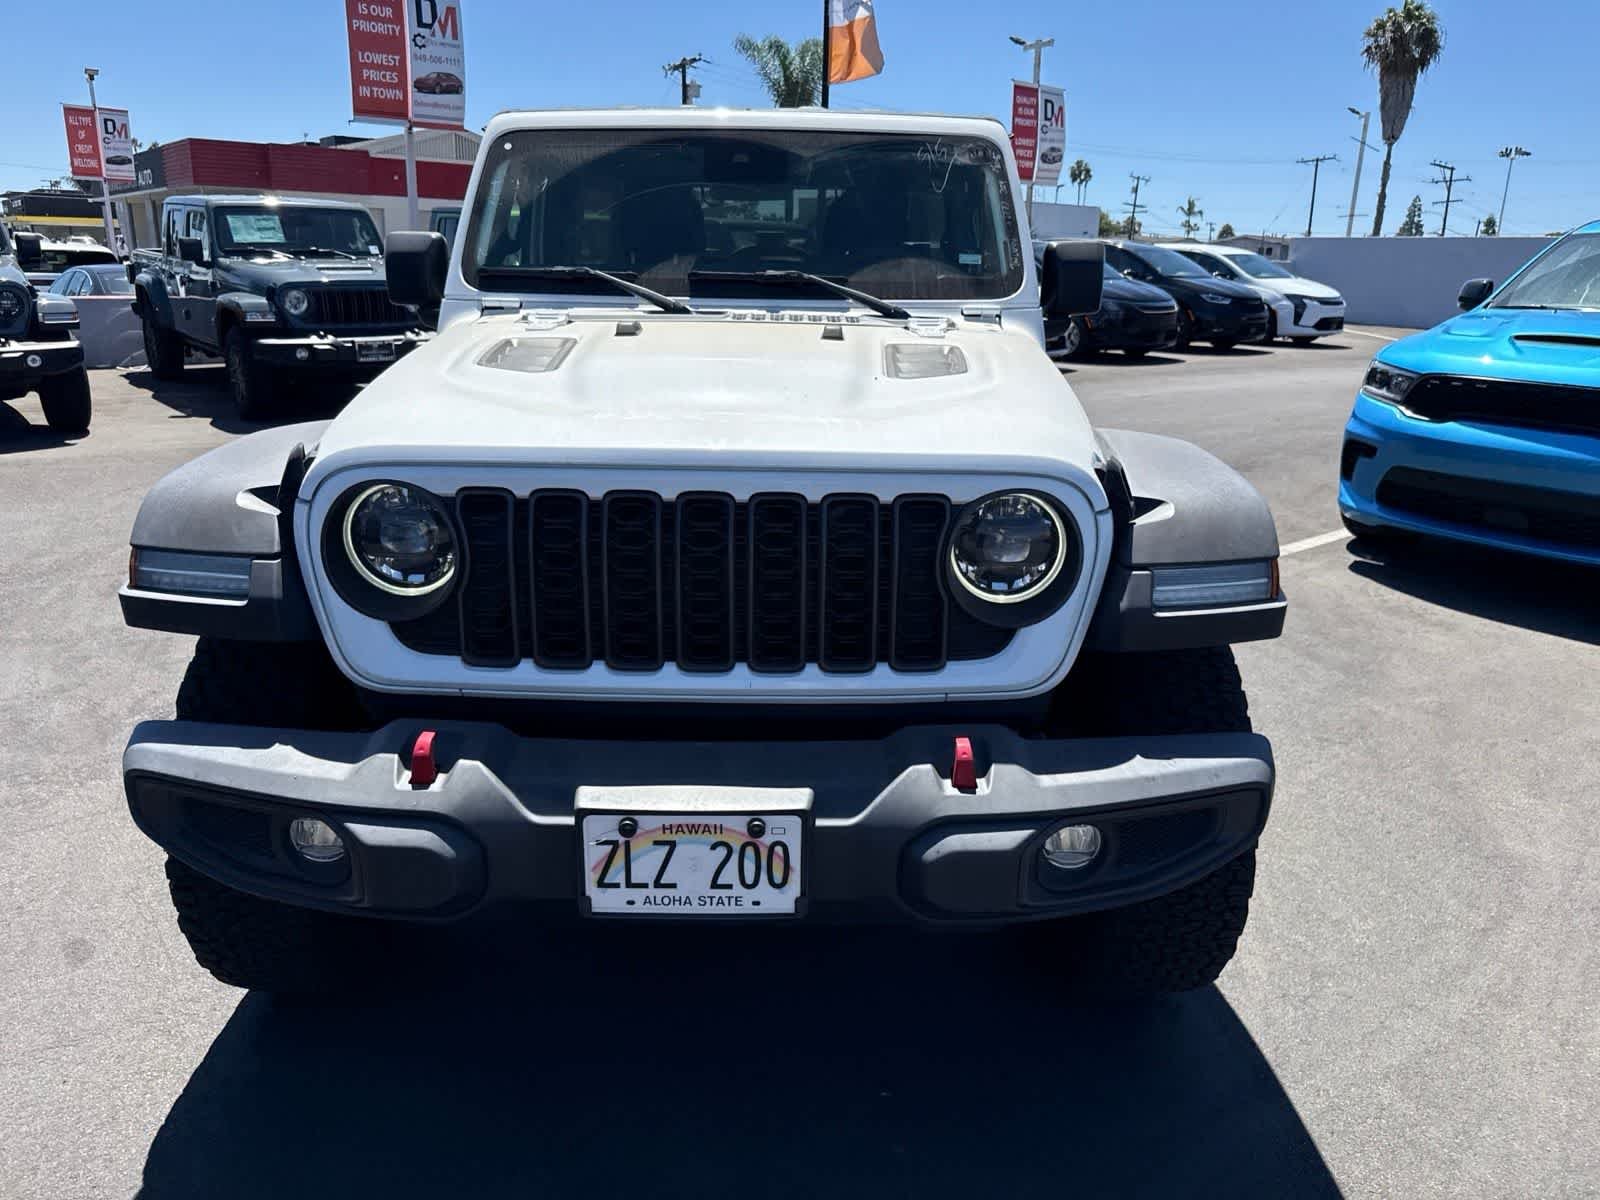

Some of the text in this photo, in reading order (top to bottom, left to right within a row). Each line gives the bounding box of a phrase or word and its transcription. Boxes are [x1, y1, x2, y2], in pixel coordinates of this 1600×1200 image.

[358, 3, 392, 18] IS OUR
[352, 20, 400, 36] PRIORITY
[358, 51, 400, 66] LOWEST
[363, 69, 398, 83] PRICES
[359, 86, 403, 101] IN TOWN
[1015, 95, 1036, 105] QUALITY
[69, 115, 92, 126] ALL TYPE
[1014, 117, 1036, 127] PRIORITY
[78, 129, 86, 139] OF
[74, 144, 93, 153] CREDIT
[1015, 138, 1035, 147] LOWEST
[1015, 149, 1033, 158] PRICES
[73, 158, 98, 168] WELCOME
[138, 170, 152, 184] AUTO
[661, 823, 724, 835] HAWAII
[596, 840, 790, 890] ZLZ 200
[642, 895, 743, 907] ALOHA STATE
